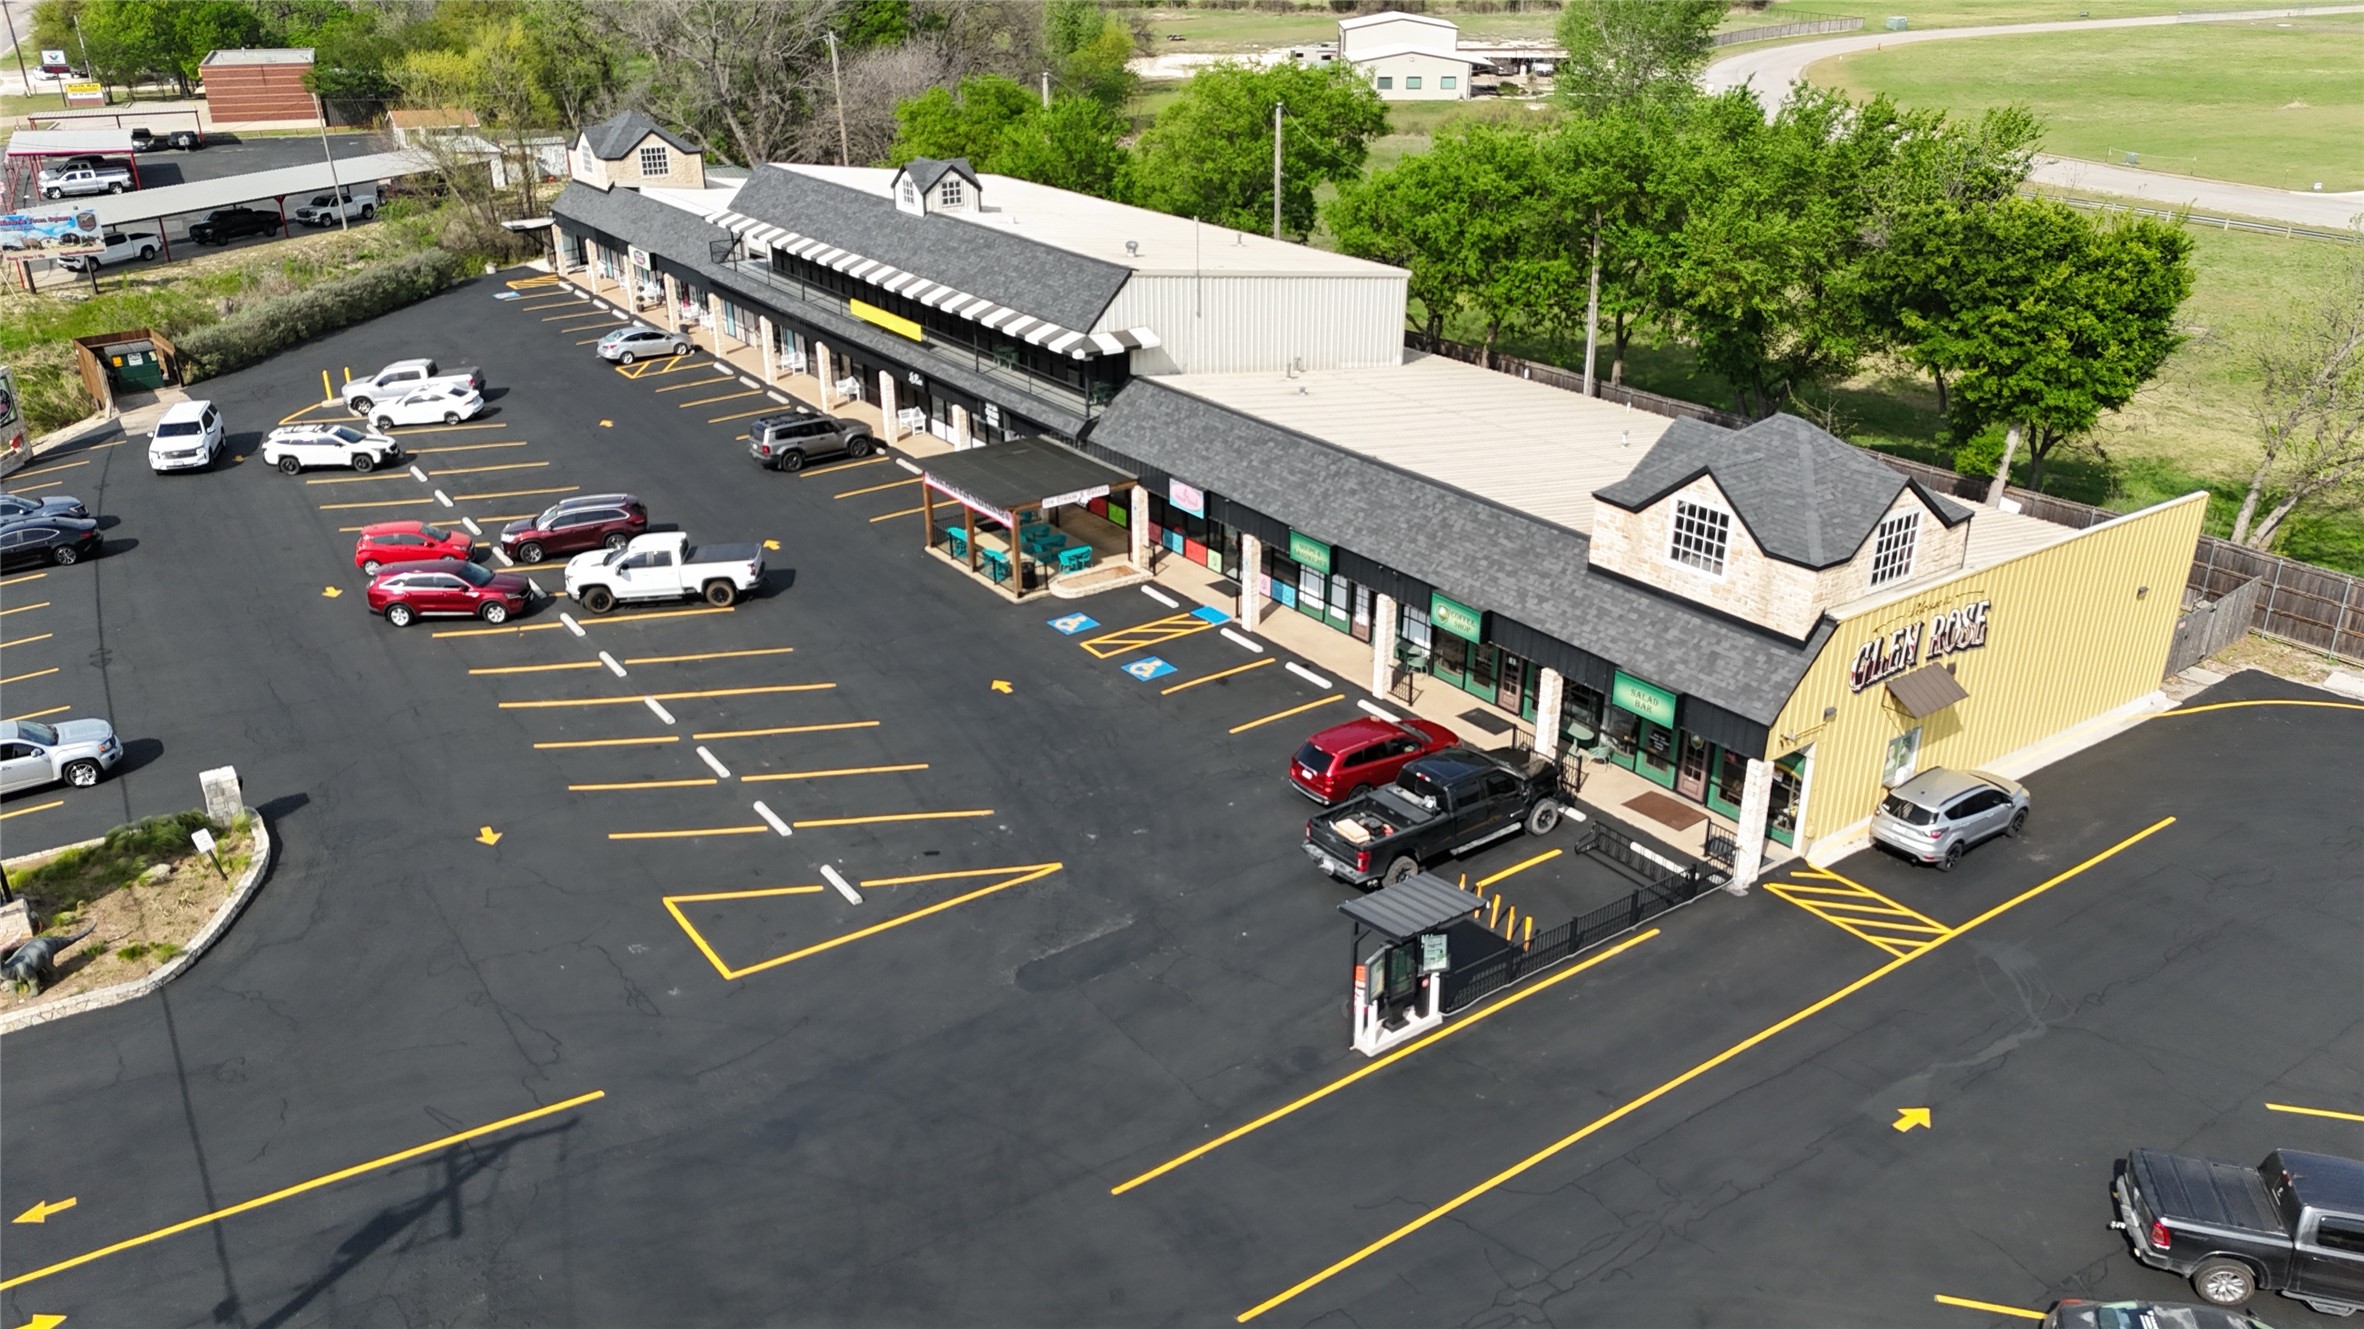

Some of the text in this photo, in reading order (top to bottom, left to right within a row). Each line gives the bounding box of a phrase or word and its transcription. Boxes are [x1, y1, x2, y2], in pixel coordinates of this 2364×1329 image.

[1450, 609, 1476, 628] COFFEE
[1454, 620, 1471, 633] SHOP
[1849, 599, 1991, 695] GLEN ROSE
[1630, 688, 1659, 707] SALAD
[1634, 699, 1653, 714] BAR
